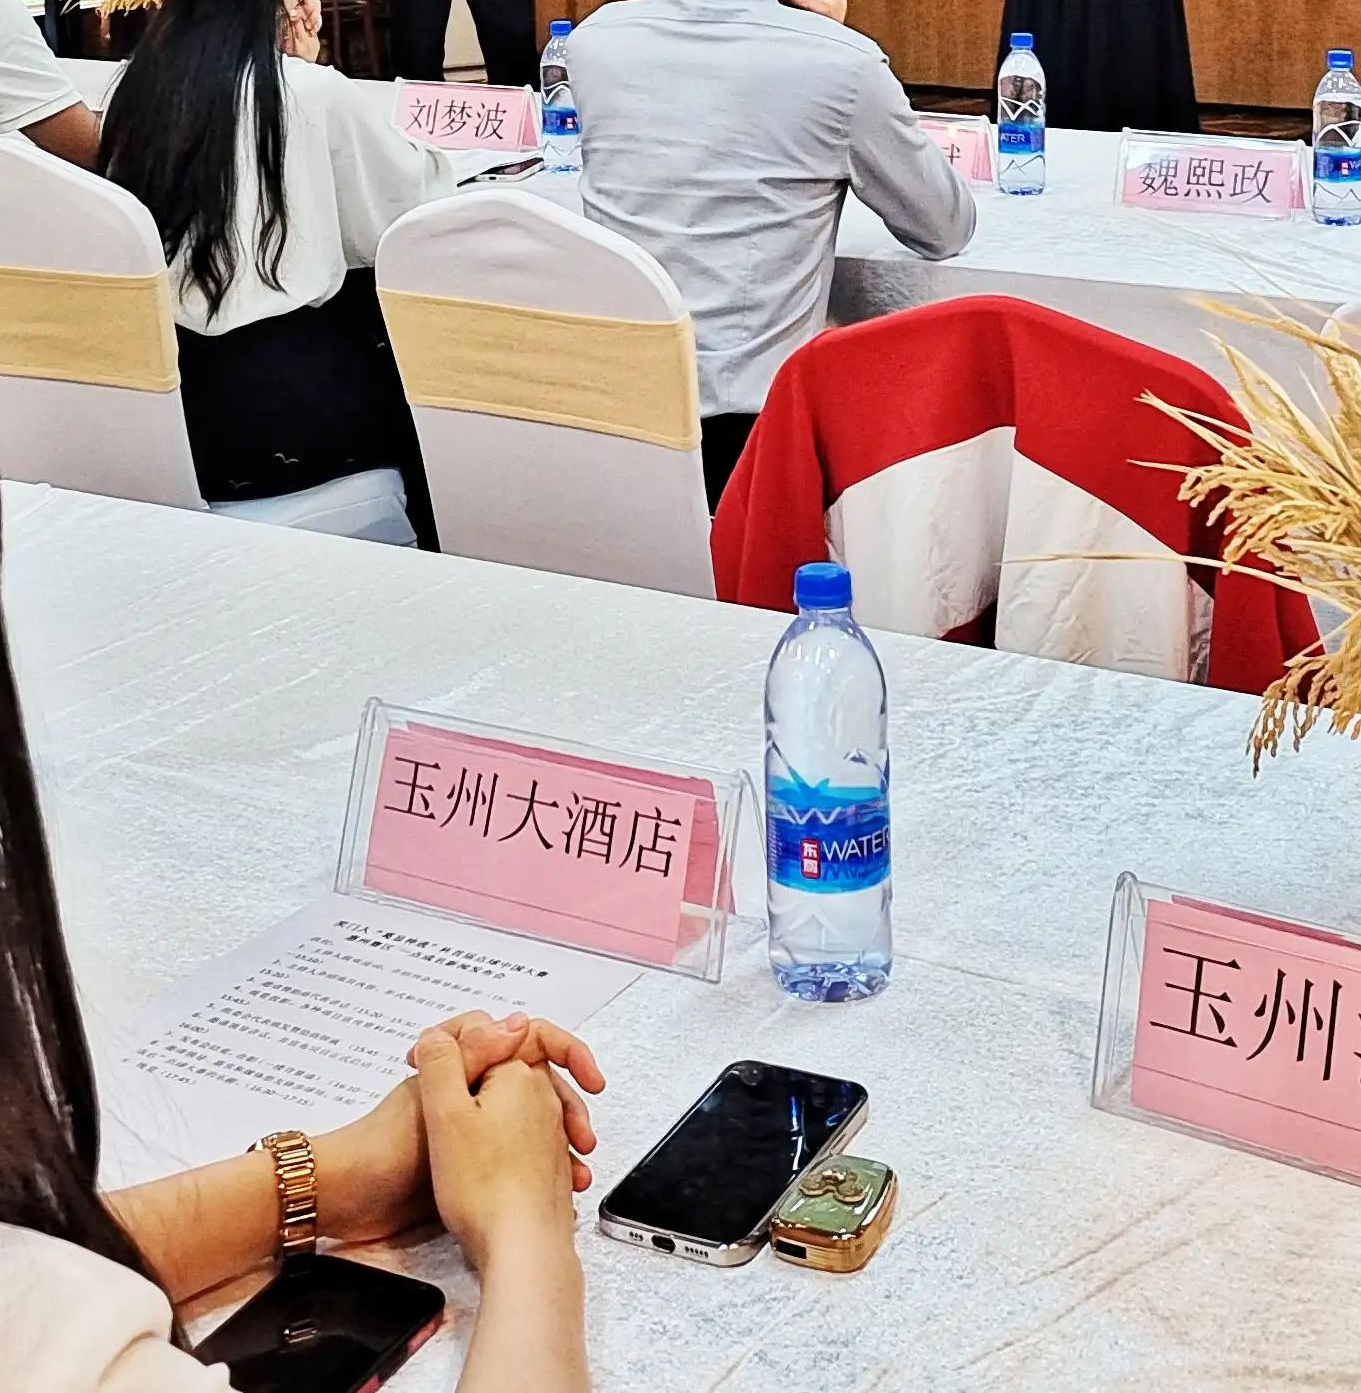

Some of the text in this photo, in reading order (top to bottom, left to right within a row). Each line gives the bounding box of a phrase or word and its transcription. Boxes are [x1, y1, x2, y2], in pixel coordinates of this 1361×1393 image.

[405, 97, 507, 141] 刘梦波
[1138, 155, 1275, 205] 魏熙政
[384, 755, 682, 879] 玉州大酒店
